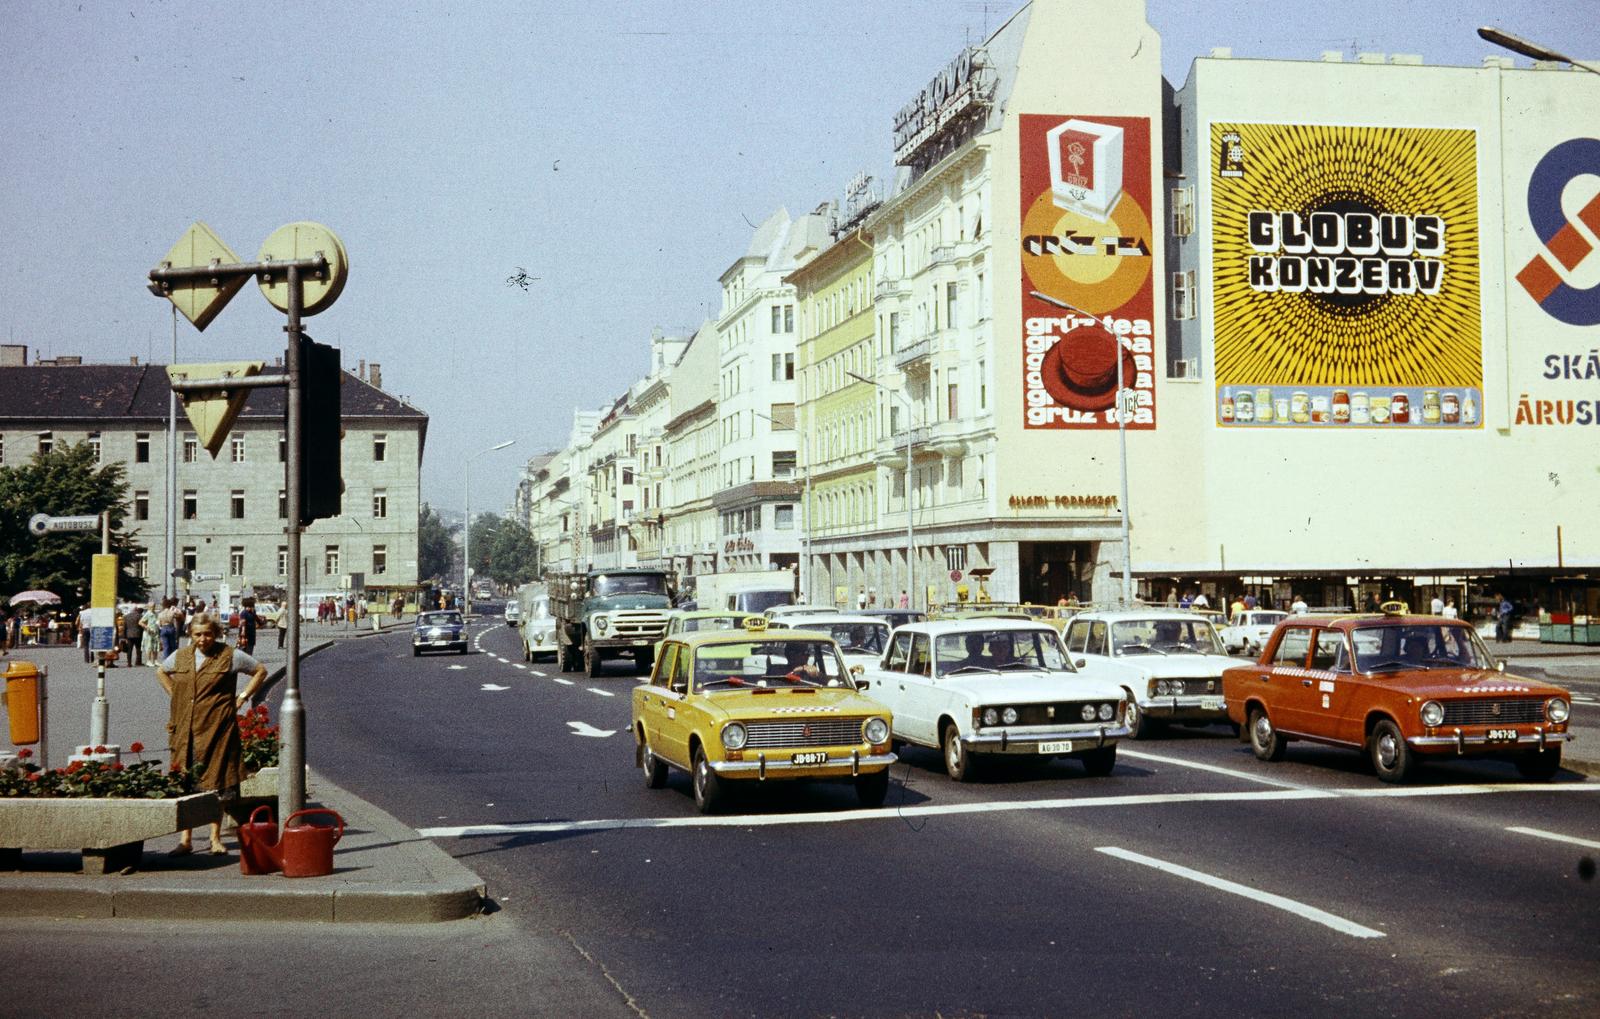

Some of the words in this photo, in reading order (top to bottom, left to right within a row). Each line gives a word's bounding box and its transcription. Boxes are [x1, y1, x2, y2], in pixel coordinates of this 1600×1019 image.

[1023, 230, 1097, 256] GRÚZ
[1101, 236, 1152, 256] TEA
[1249, 211, 1445, 255] GLOBUS
[1249, 256, 1444, 294] KONZERV
[1103, 315, 1152, 335] tea
[54, 521, 93, 529] AUTOBUSZ
[747, 618, 765, 627] TAXI
